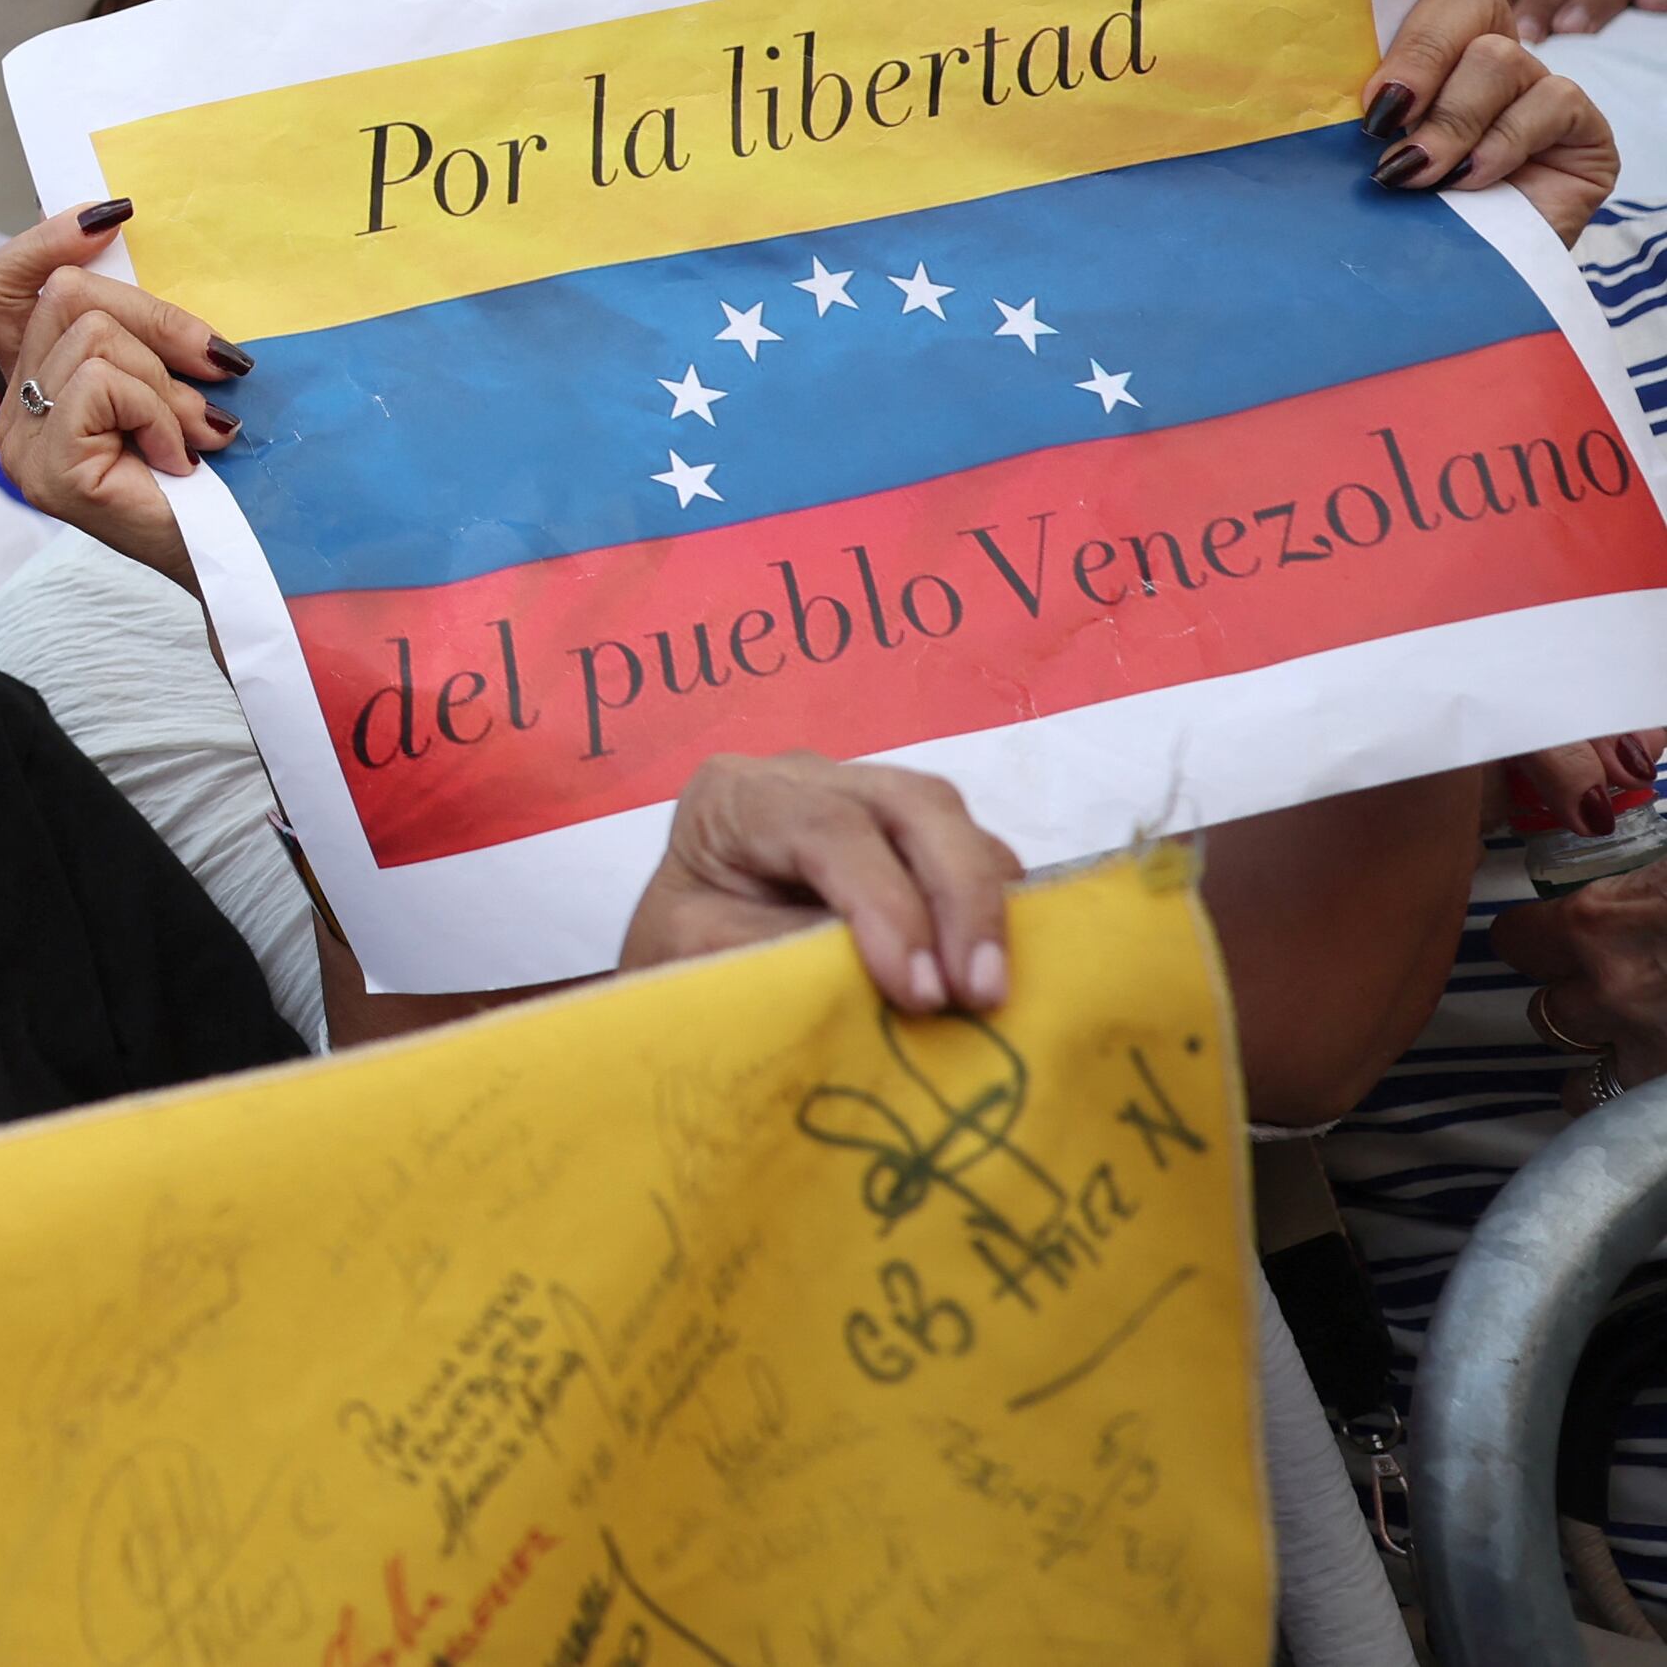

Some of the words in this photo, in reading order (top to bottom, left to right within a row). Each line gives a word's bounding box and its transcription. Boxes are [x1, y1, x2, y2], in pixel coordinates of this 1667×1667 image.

[353, 121, 547, 238] Por
[584, 73, 691, 188] la
[352, 620, 538, 770] del
[566, 547, 966, 763] pueblo
[957, 427, 1631, 620] Venezolano
